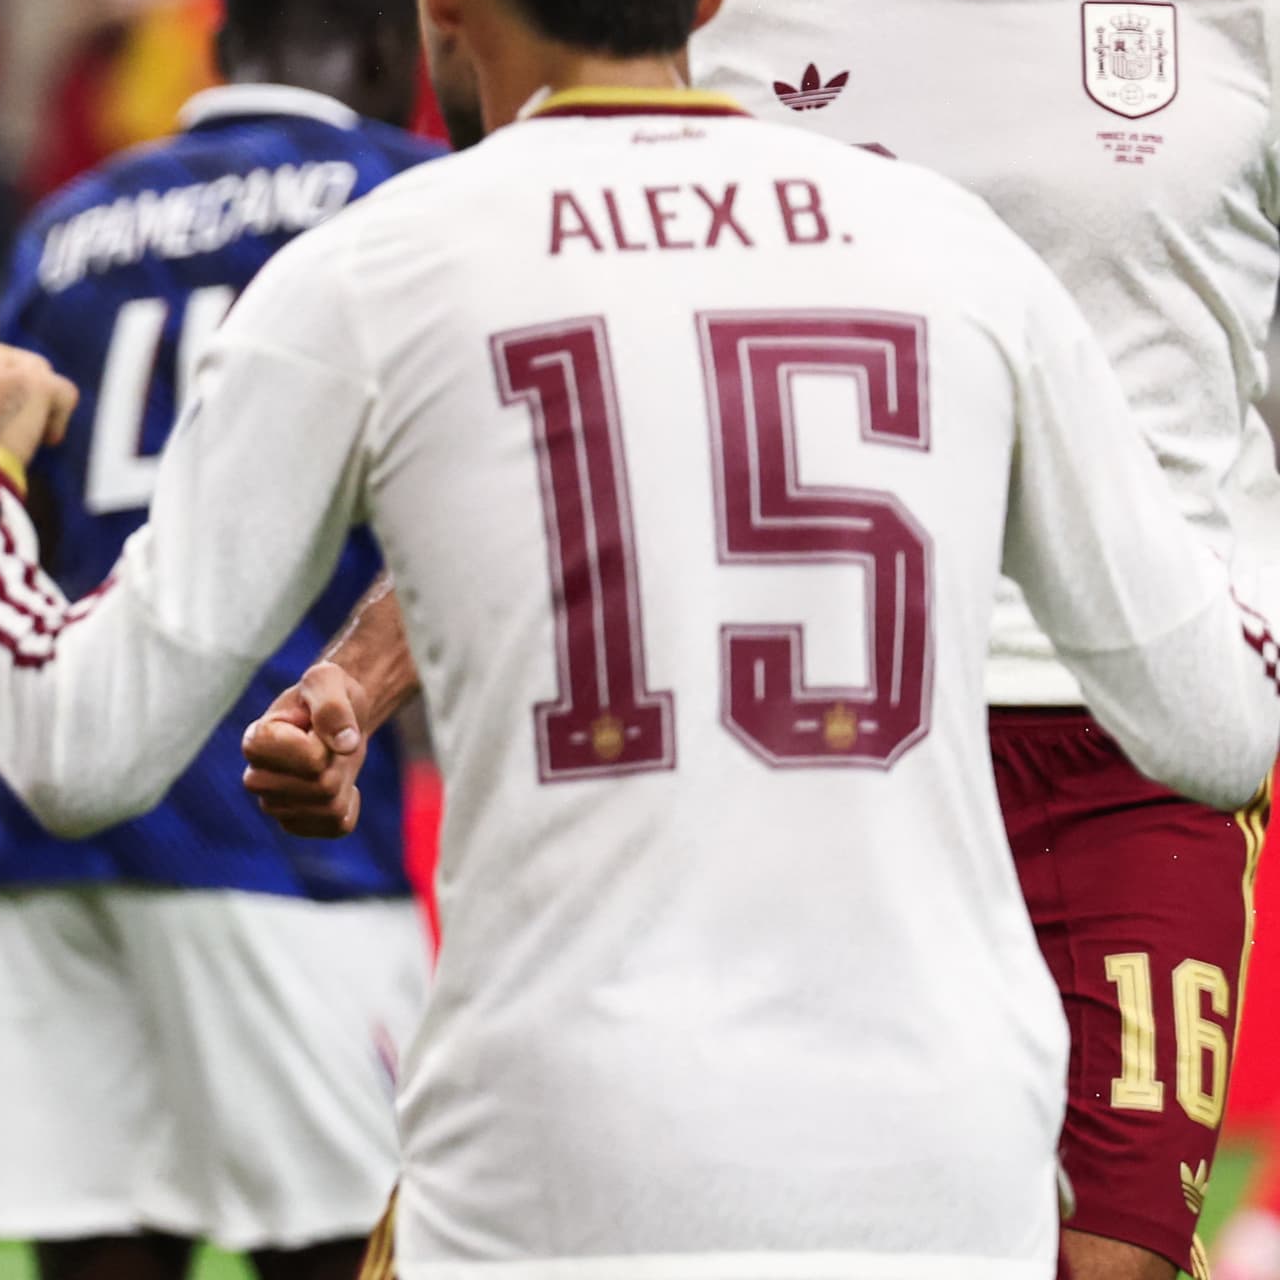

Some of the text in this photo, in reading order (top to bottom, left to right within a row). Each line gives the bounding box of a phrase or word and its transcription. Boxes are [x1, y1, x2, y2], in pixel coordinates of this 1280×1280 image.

[38, 160, 357, 294] UPAMECANO
[548, 178, 854, 256] ALEX B.
[489, 310, 935, 783] 15
[1104, 952, 1230, 1130] 16
